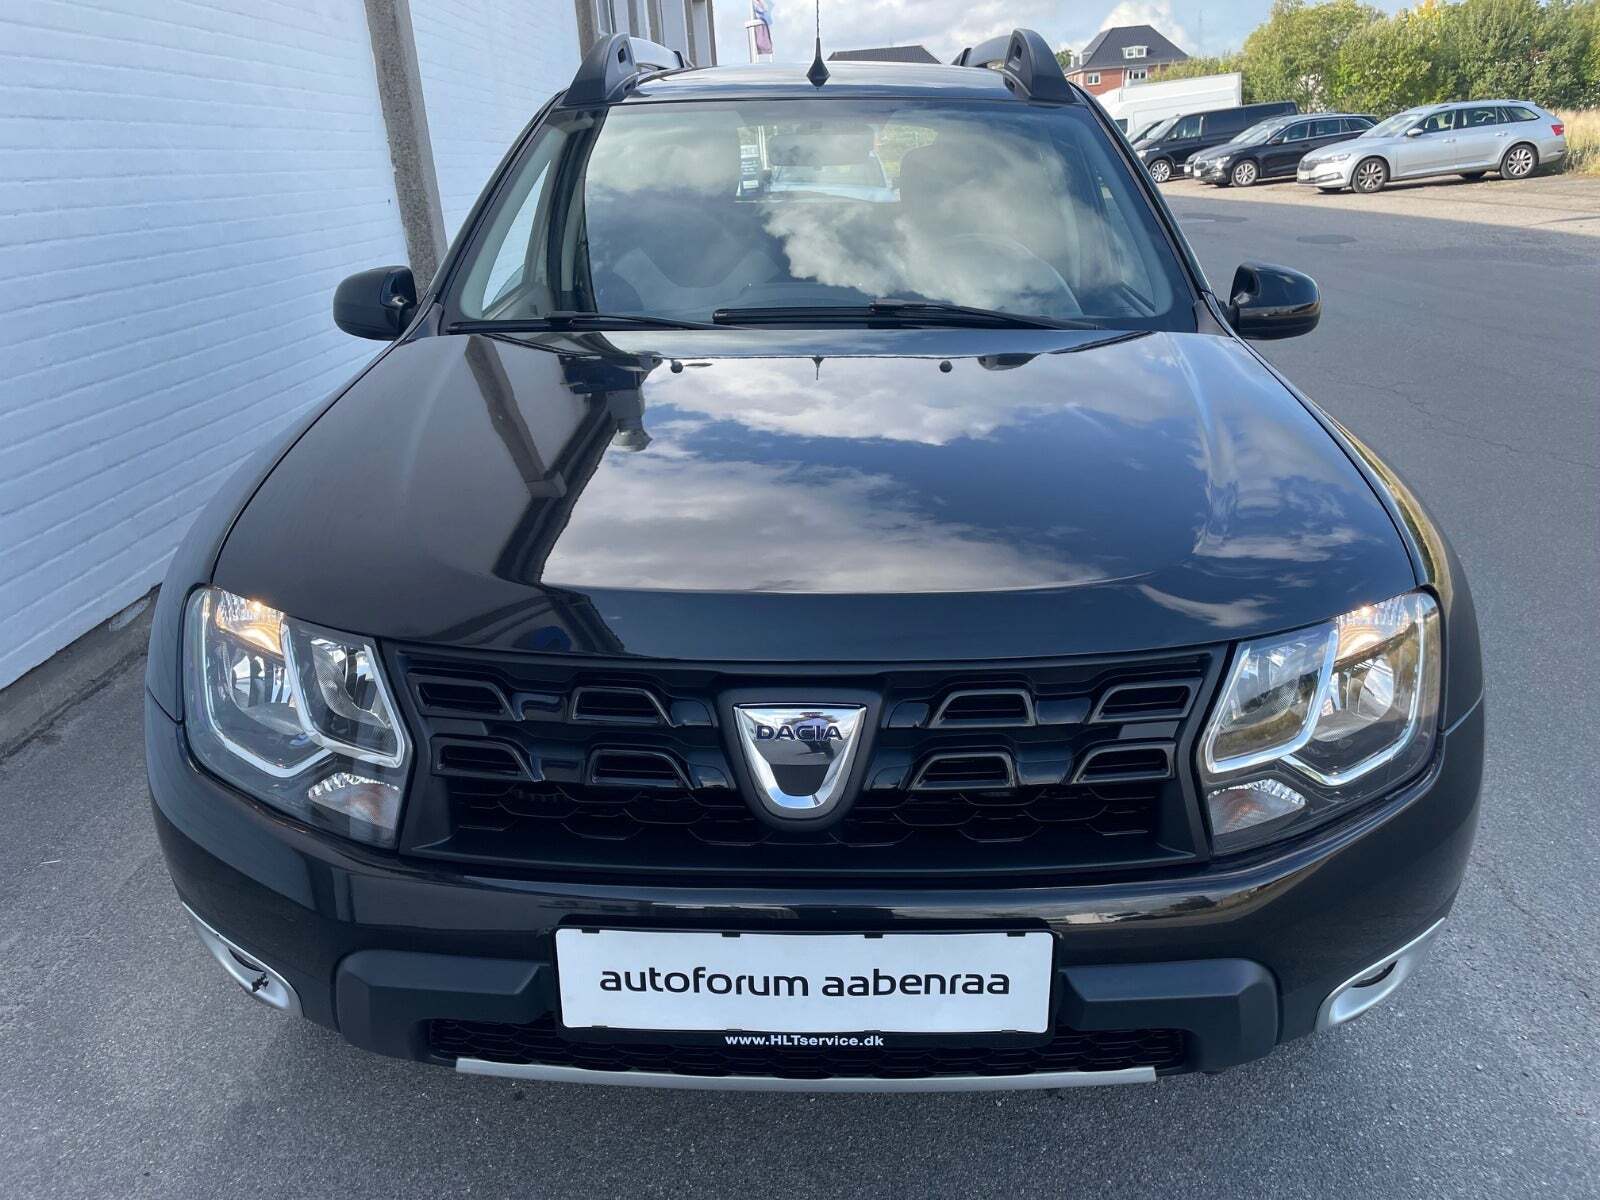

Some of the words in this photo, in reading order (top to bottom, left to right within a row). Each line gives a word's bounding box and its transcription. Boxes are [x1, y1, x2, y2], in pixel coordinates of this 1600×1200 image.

[756, 725, 843, 741] DACIA
[599, 966, 809, 997] autoforum
[821, 968, 1010, 997] aabenraa
[724, 1034, 884, 1047] www.HLTservice.dk
